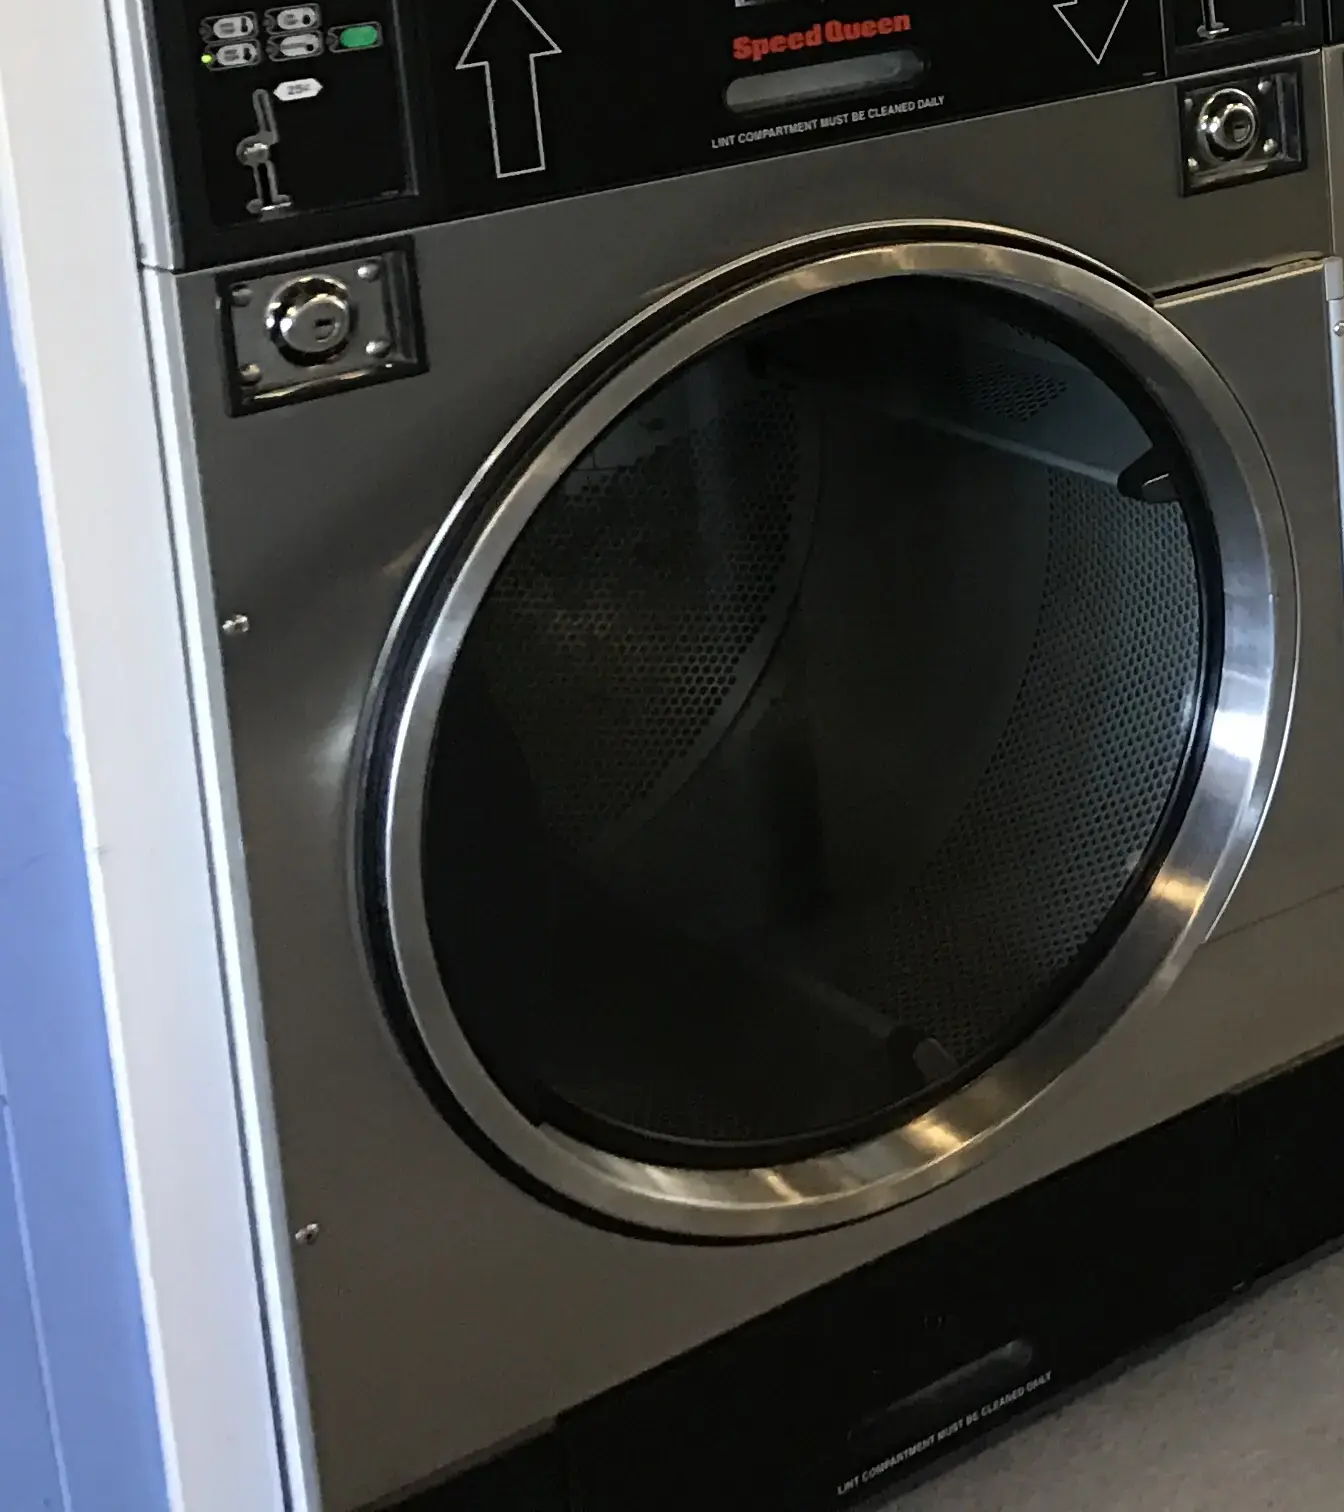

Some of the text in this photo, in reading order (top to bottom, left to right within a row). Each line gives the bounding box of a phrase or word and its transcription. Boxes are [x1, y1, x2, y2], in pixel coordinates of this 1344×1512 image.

[732, 13, 912, 62] Speed Queen
[711, 95, 945, 149] LINT COMPARTMENT MUST BE CLEANED DAILY
[861, 1434, 935, 1483] COMPARTMENT
[937, 1418, 964, 1441] MUST
[981, 1386, 1025, 1417] CLEANED
